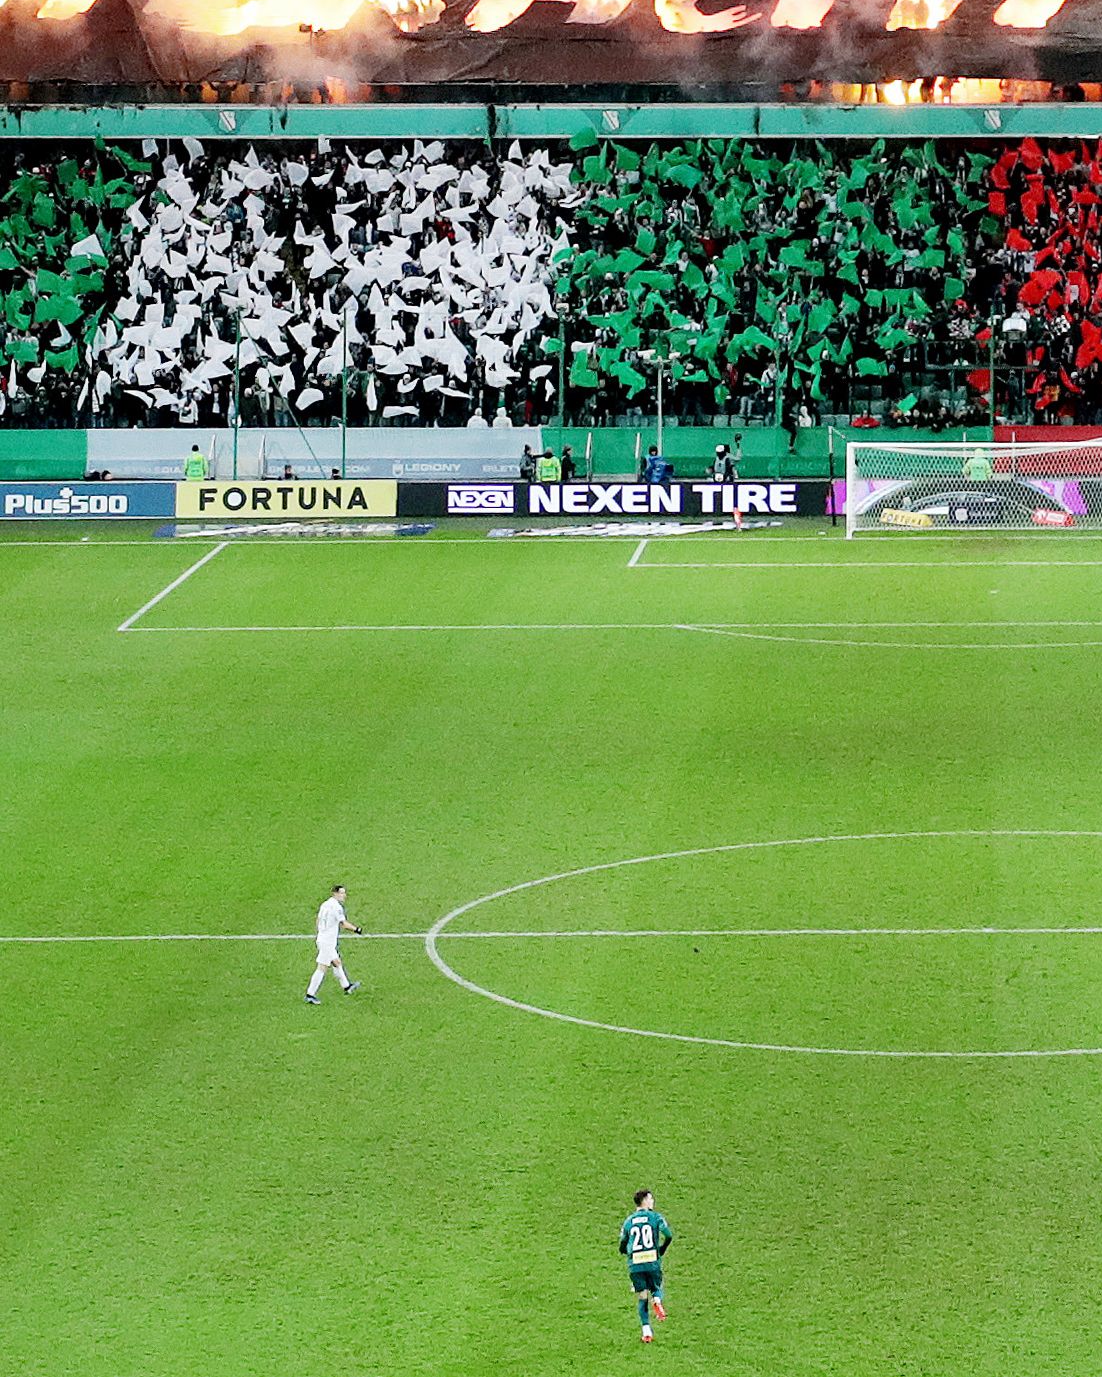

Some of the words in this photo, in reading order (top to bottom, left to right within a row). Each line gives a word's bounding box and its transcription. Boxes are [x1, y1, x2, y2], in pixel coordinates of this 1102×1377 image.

[4, 487, 129, 514] Plus500
[200, 487, 368, 510] FORTUNA
[529, 484, 681, 513] NEXEN
[692, 484, 797, 513] TIRE
[630, 1224, 654, 1251] 20
